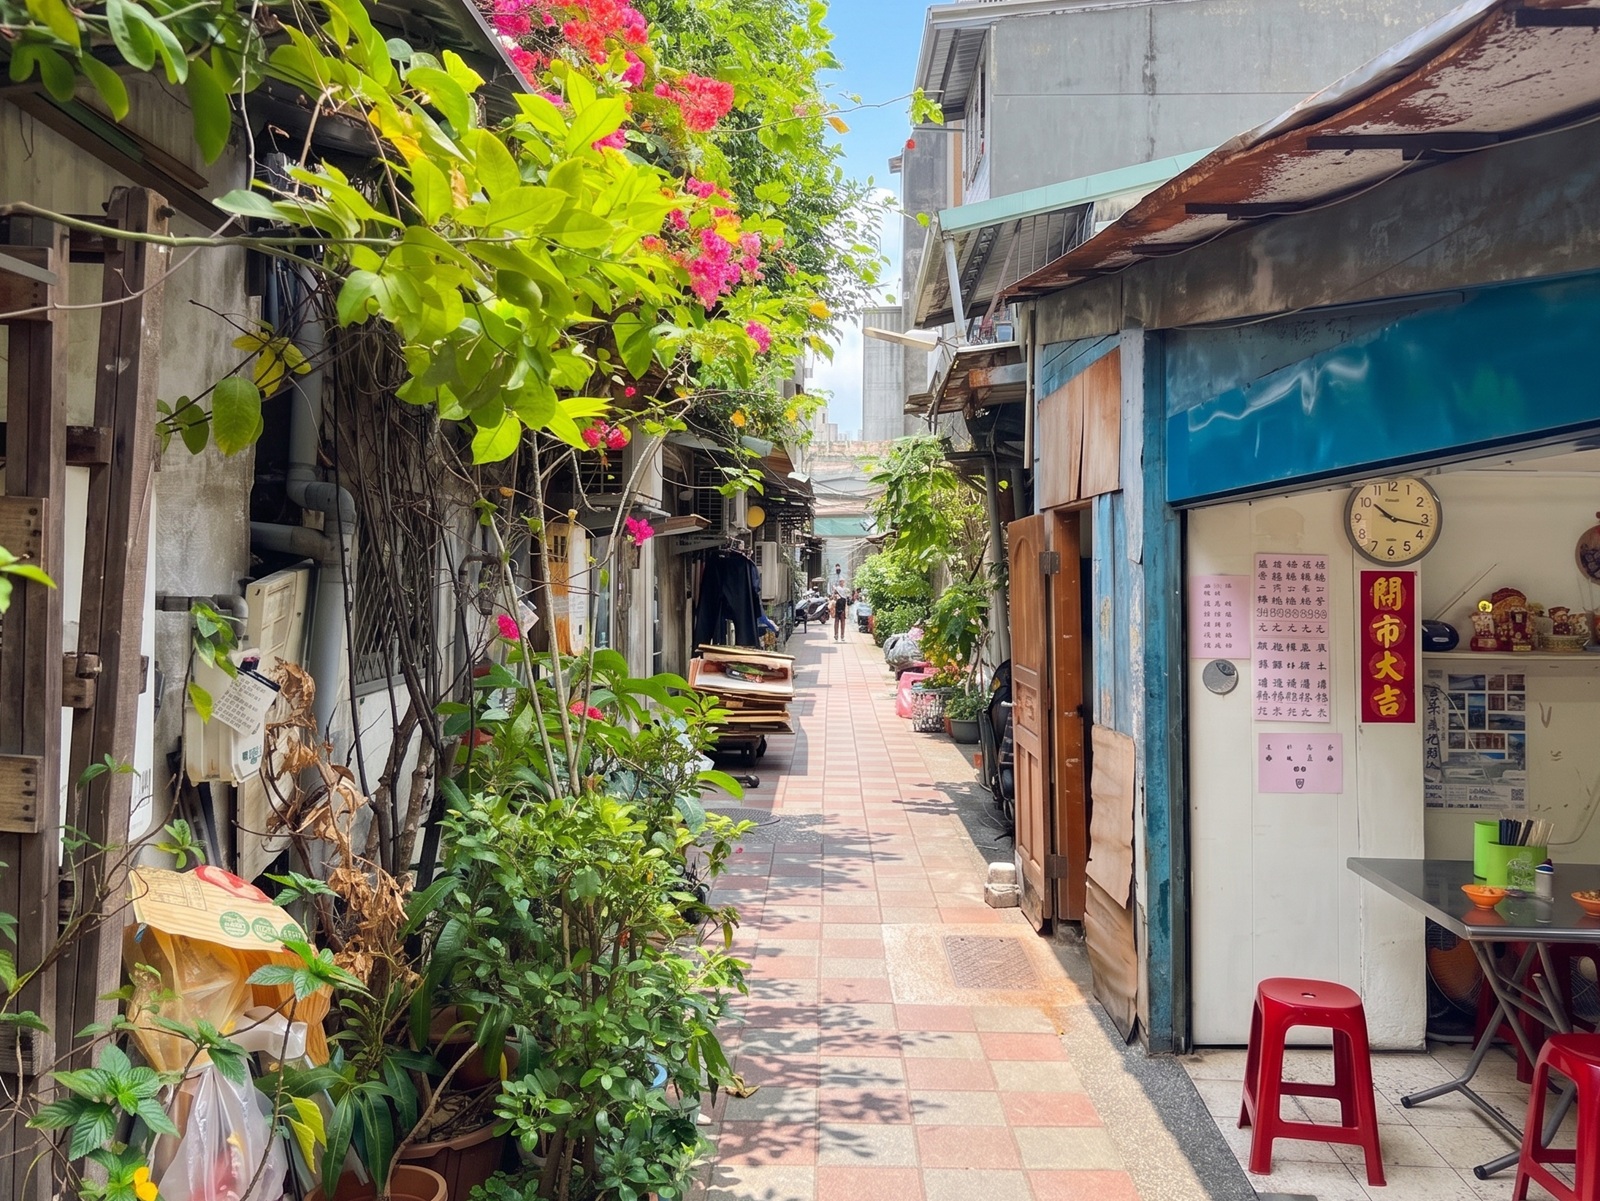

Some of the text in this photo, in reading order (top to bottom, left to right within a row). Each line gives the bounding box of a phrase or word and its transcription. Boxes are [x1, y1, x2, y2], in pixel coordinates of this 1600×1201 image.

[1373, 485, 1382, 496] 11
[1387, 481, 1398, 492] 12
[1406, 484, 1410, 495] 1
[1360, 497, 1372, 508] 10
[1416, 497, 1424, 507] 2
[1354, 513, 1362, 523] 9
[1421, 513, 1429, 524] 3
[1358, 528, 1366, 540] 8
[1415, 529, 1424, 540] 4
[1371, 540, 1378, 552] 7
[1387, 546, 1395, 556] 6
[1403, 540, 1411, 552] 5
[1372, 576, 1404, 716] 開市大吉
